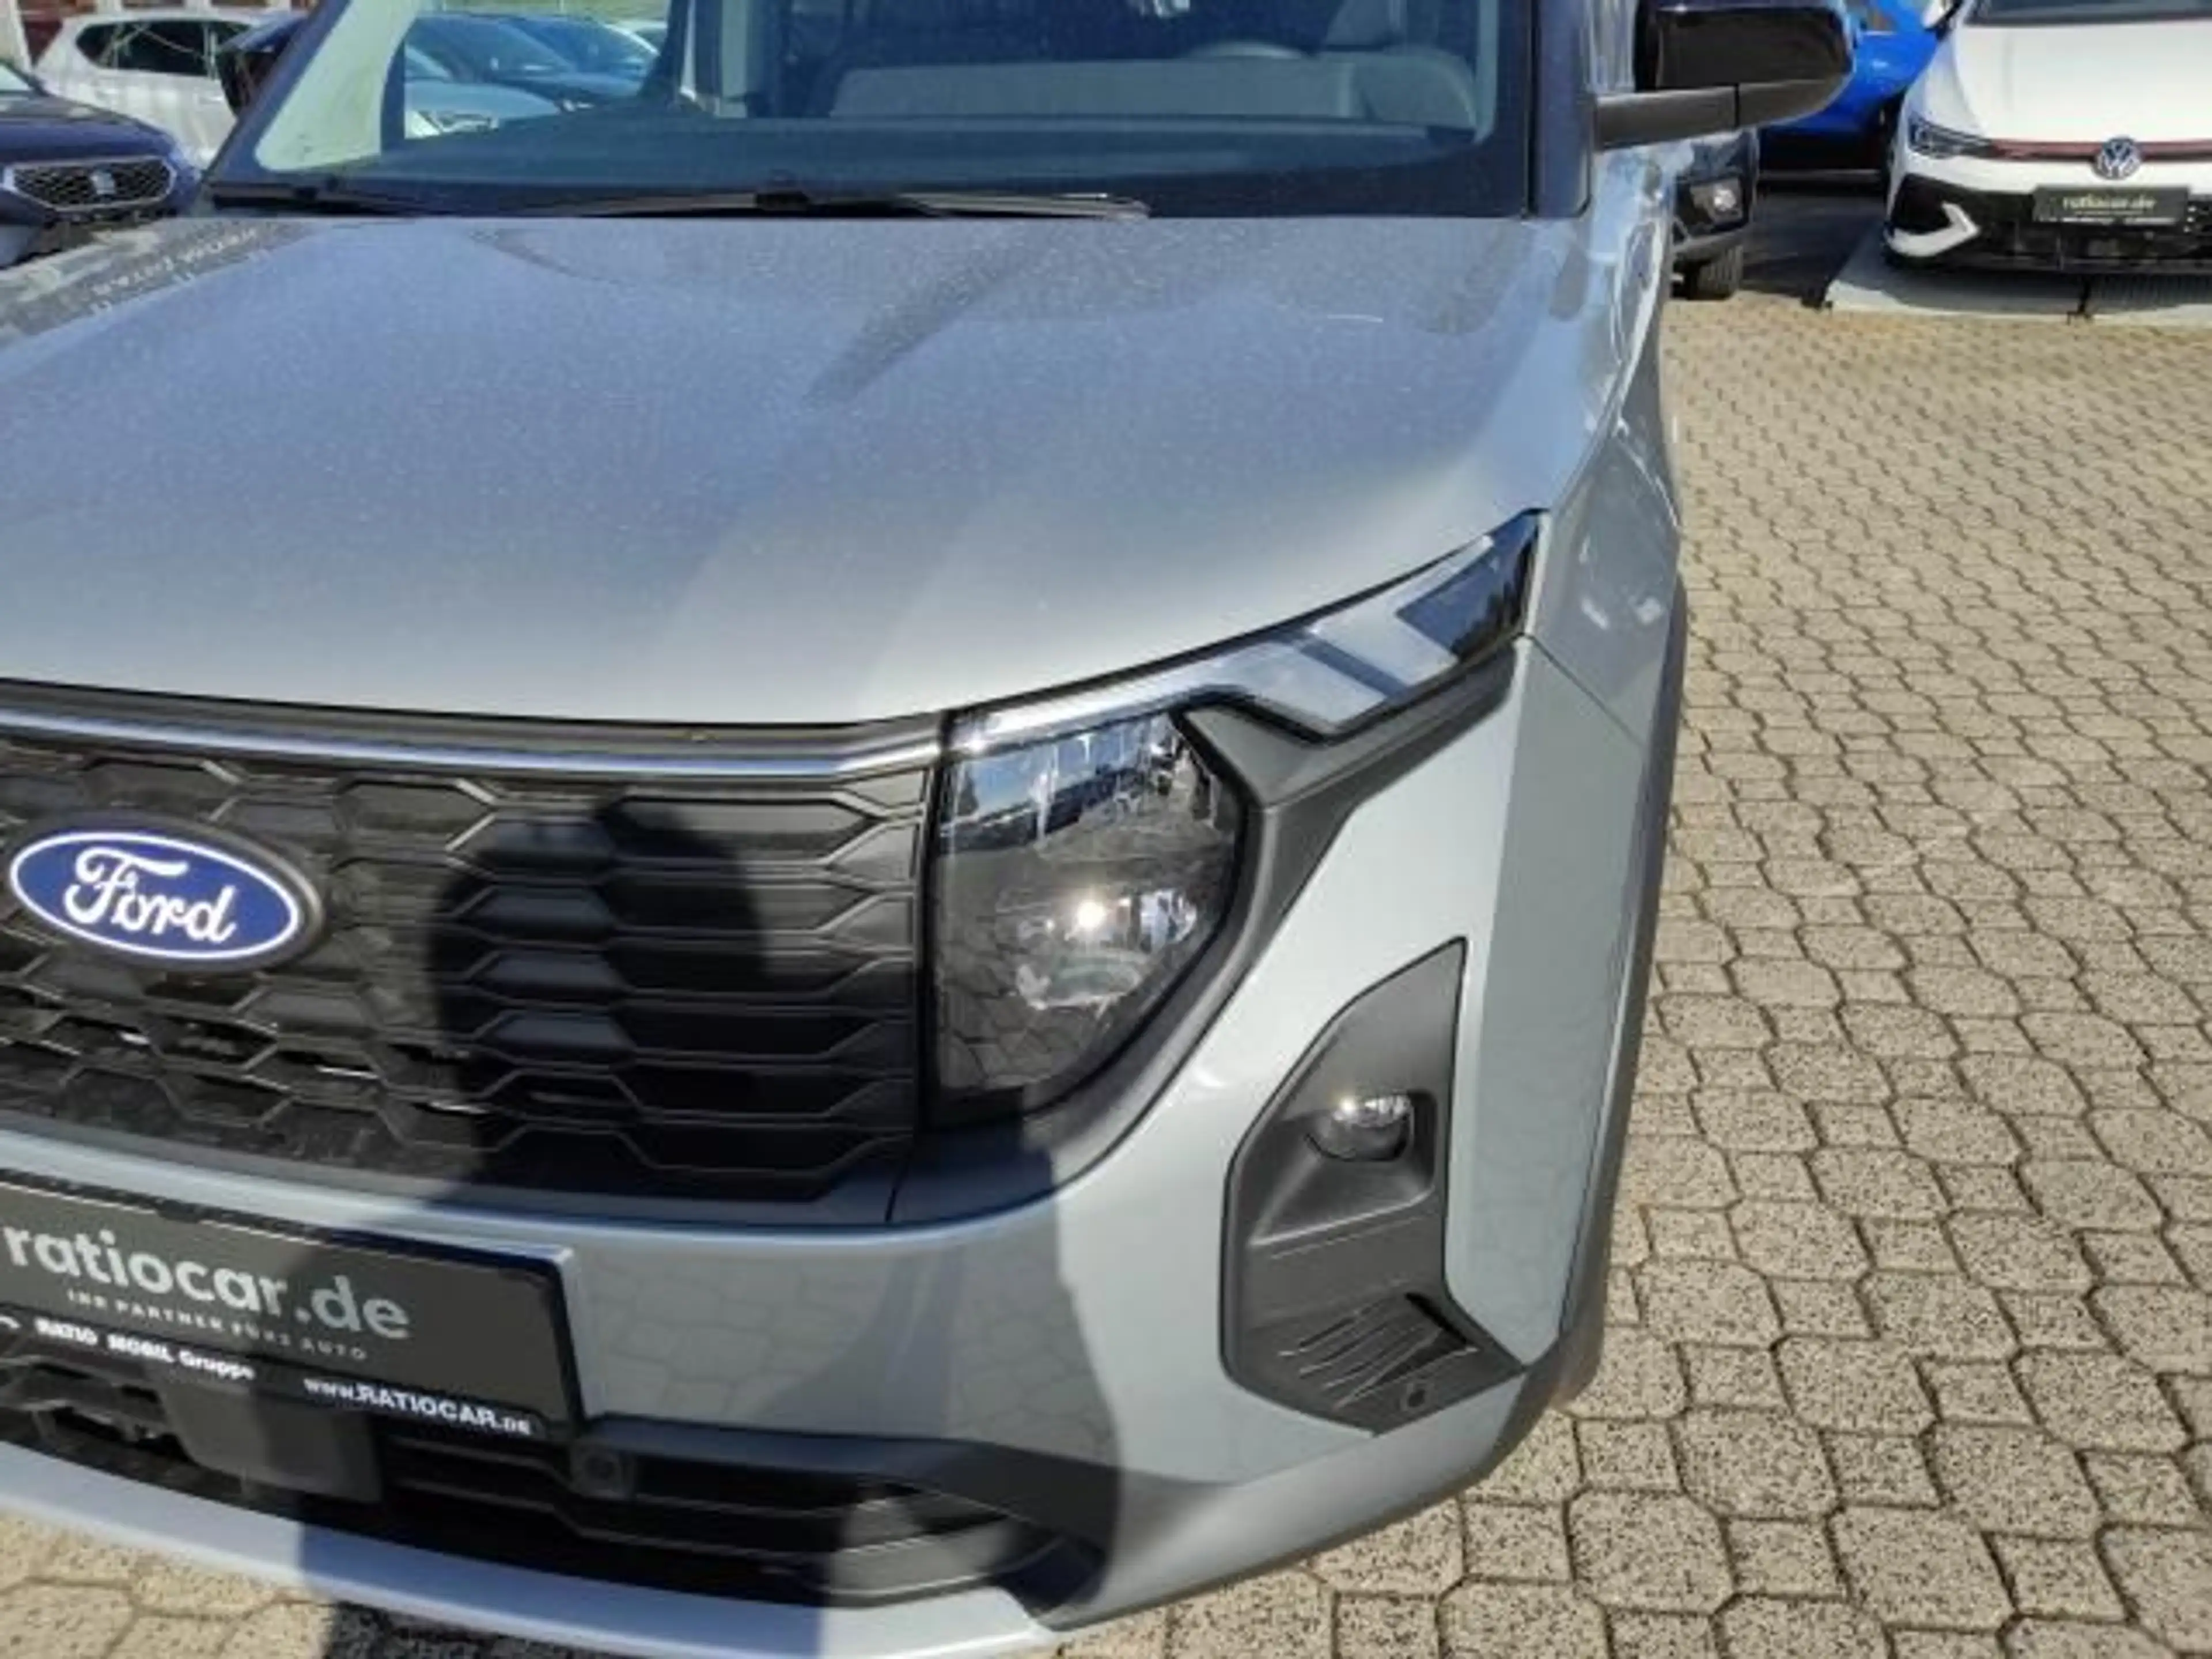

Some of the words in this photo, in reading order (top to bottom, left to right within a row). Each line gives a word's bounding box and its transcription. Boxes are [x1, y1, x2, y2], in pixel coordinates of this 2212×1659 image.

[64, 847, 236, 944] Ford
[3, 1226, 411, 1339] ratiocar.de
[35, 1317, 99, 1346] RATIO
[107, 1334, 175, 1363] MOBIL
[179, 1350, 255, 1380] Gruppe
[115, 1299, 224, 1331] PARTNER
[300, 1337, 366, 1360] AUTO
